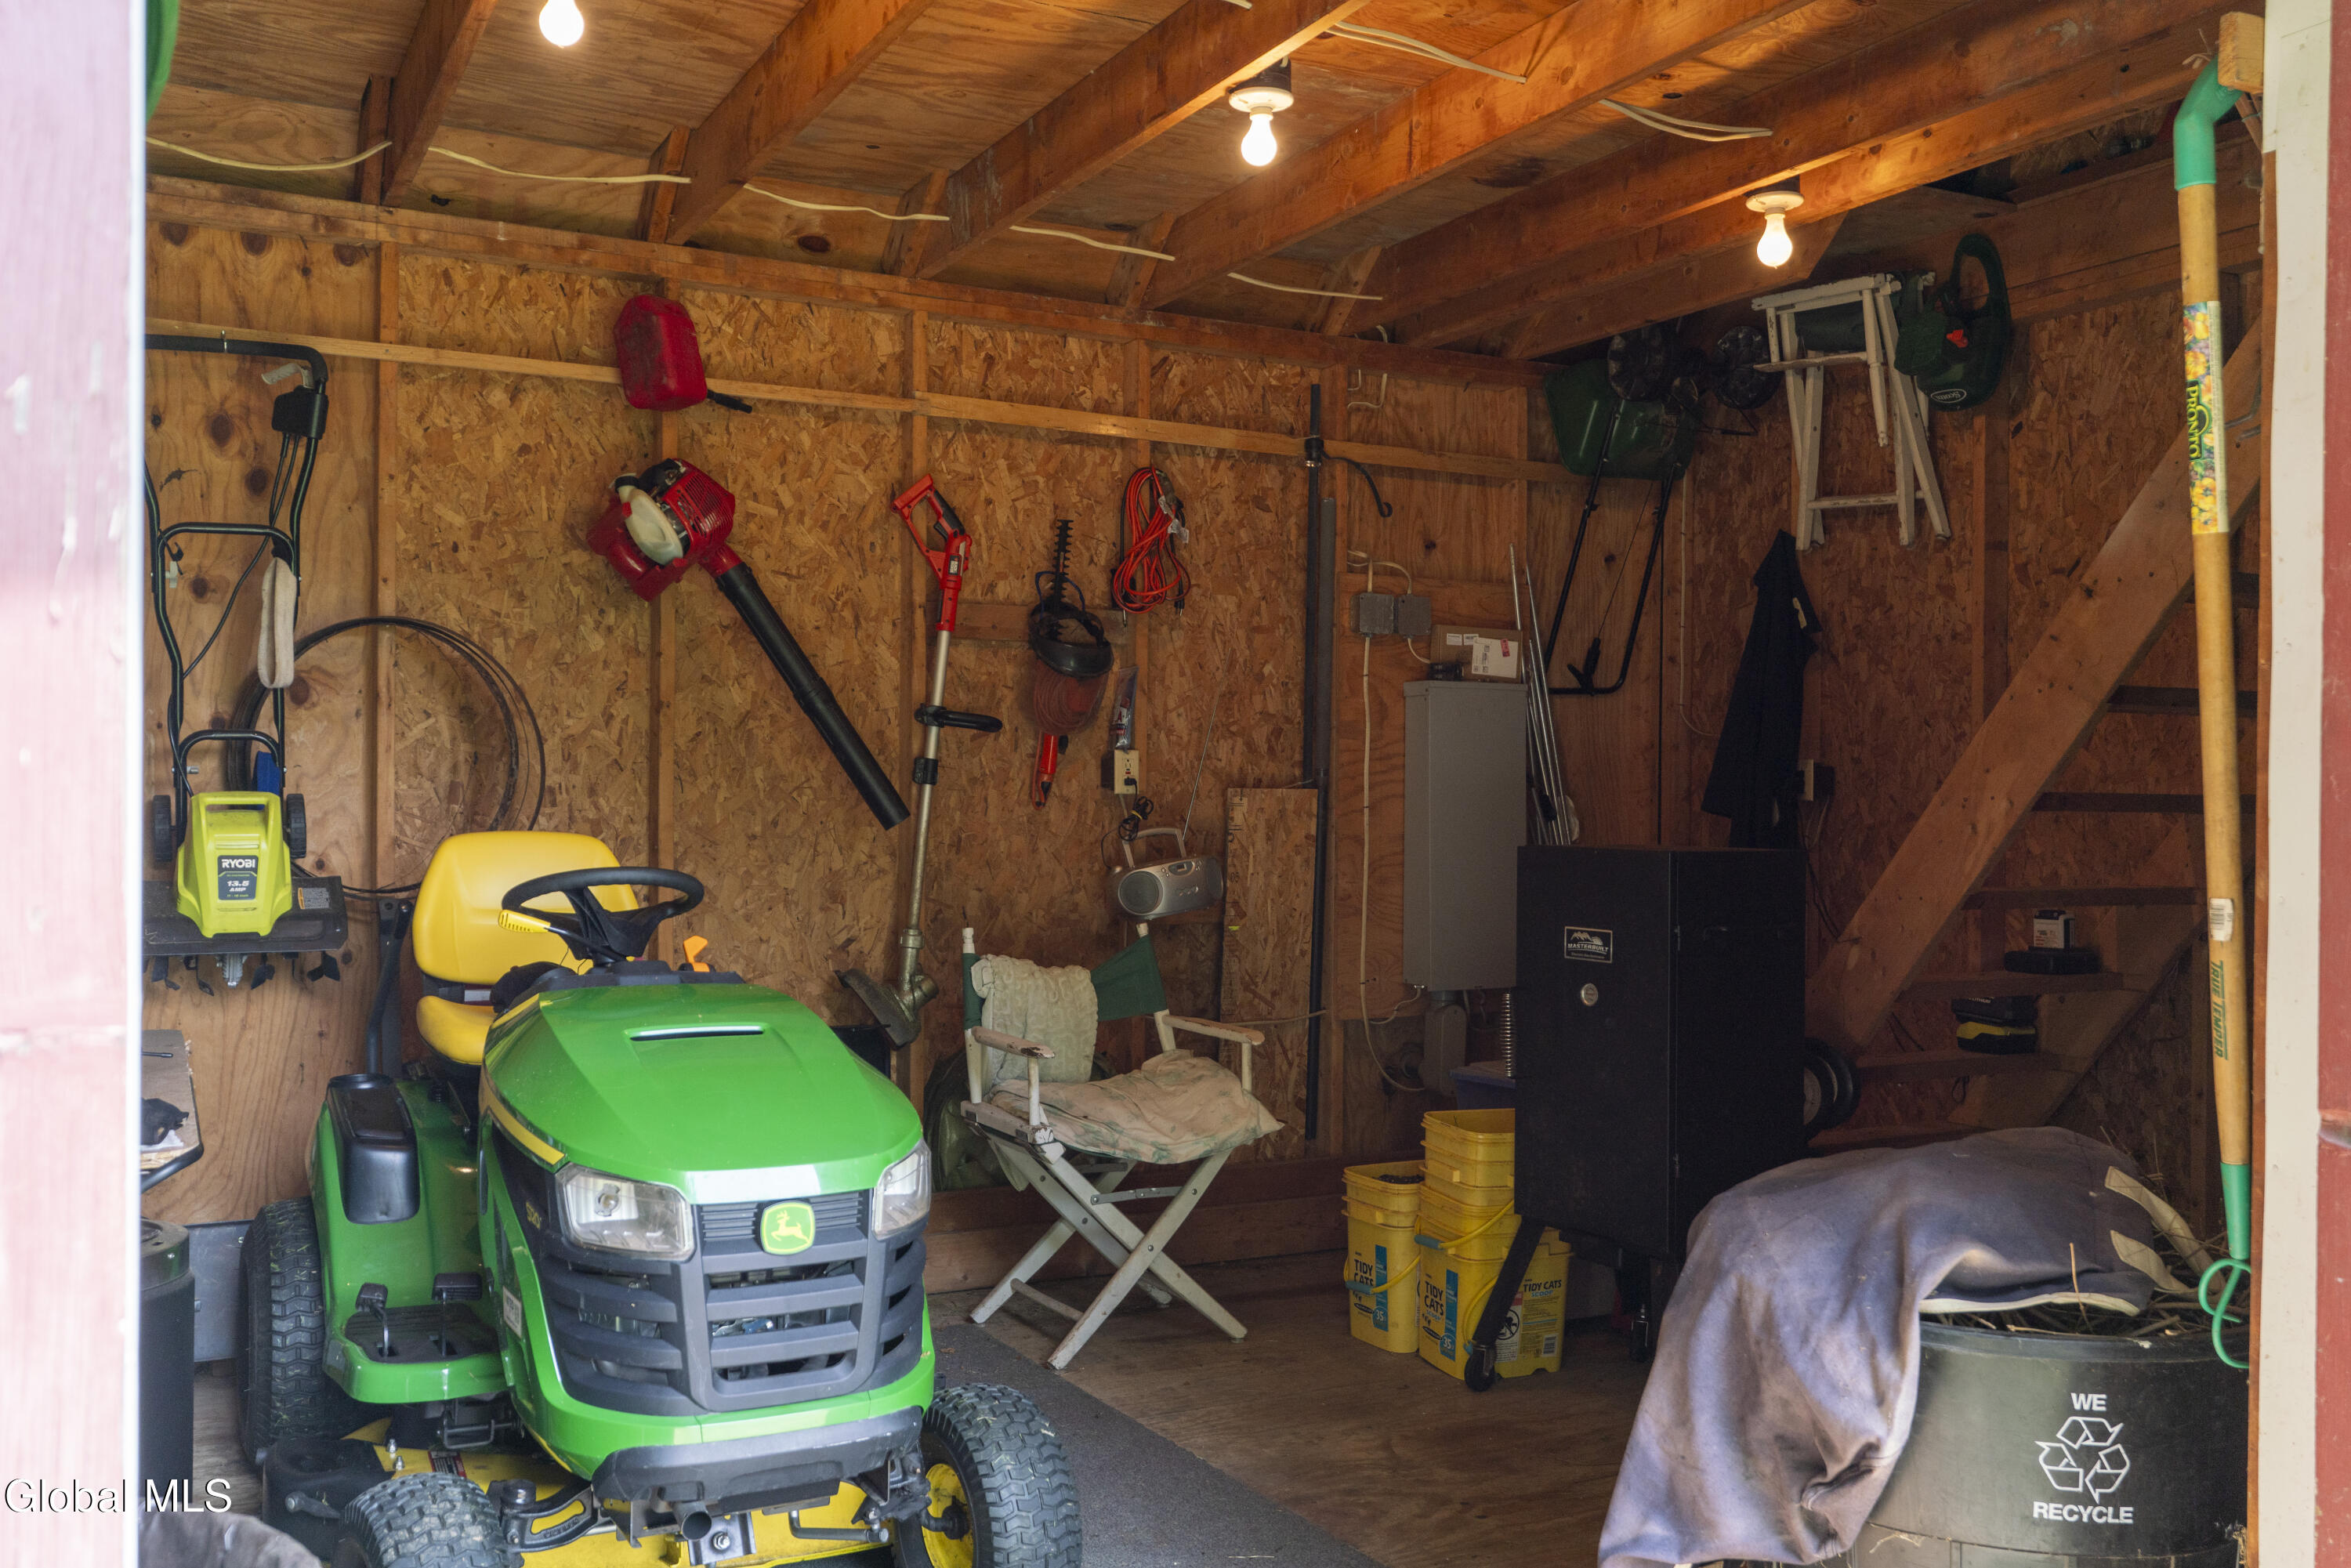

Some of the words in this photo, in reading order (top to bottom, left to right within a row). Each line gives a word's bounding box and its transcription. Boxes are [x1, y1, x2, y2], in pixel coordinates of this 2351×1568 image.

[2186, 385, 2201, 458] PRONTO
[222, 859, 255, 868] RYOBI
[1567, 943, 1609, 952] MASTERBUILT
[2211, 960, 2224, 998] TRUE
[2212, 999, 2228, 1059] TEMPER
[1354, 1258, 1373, 1276] TIDY
[1354, 1273, 1374, 1287] CATS
[1523, 1282, 1542, 1293] TIDY
[1543, 1279, 1562, 1291] CATS
[1425, 1280, 1444, 1301] TIDY
[1375, 1309, 1385, 1321] 35
[1424, 1295, 1444, 1316] CATS
[1444, 1337, 1451, 1349] 35
[2070, 1392, 2107, 1412] WE
[2033, 1501, 2134, 1525] RECYCLE
